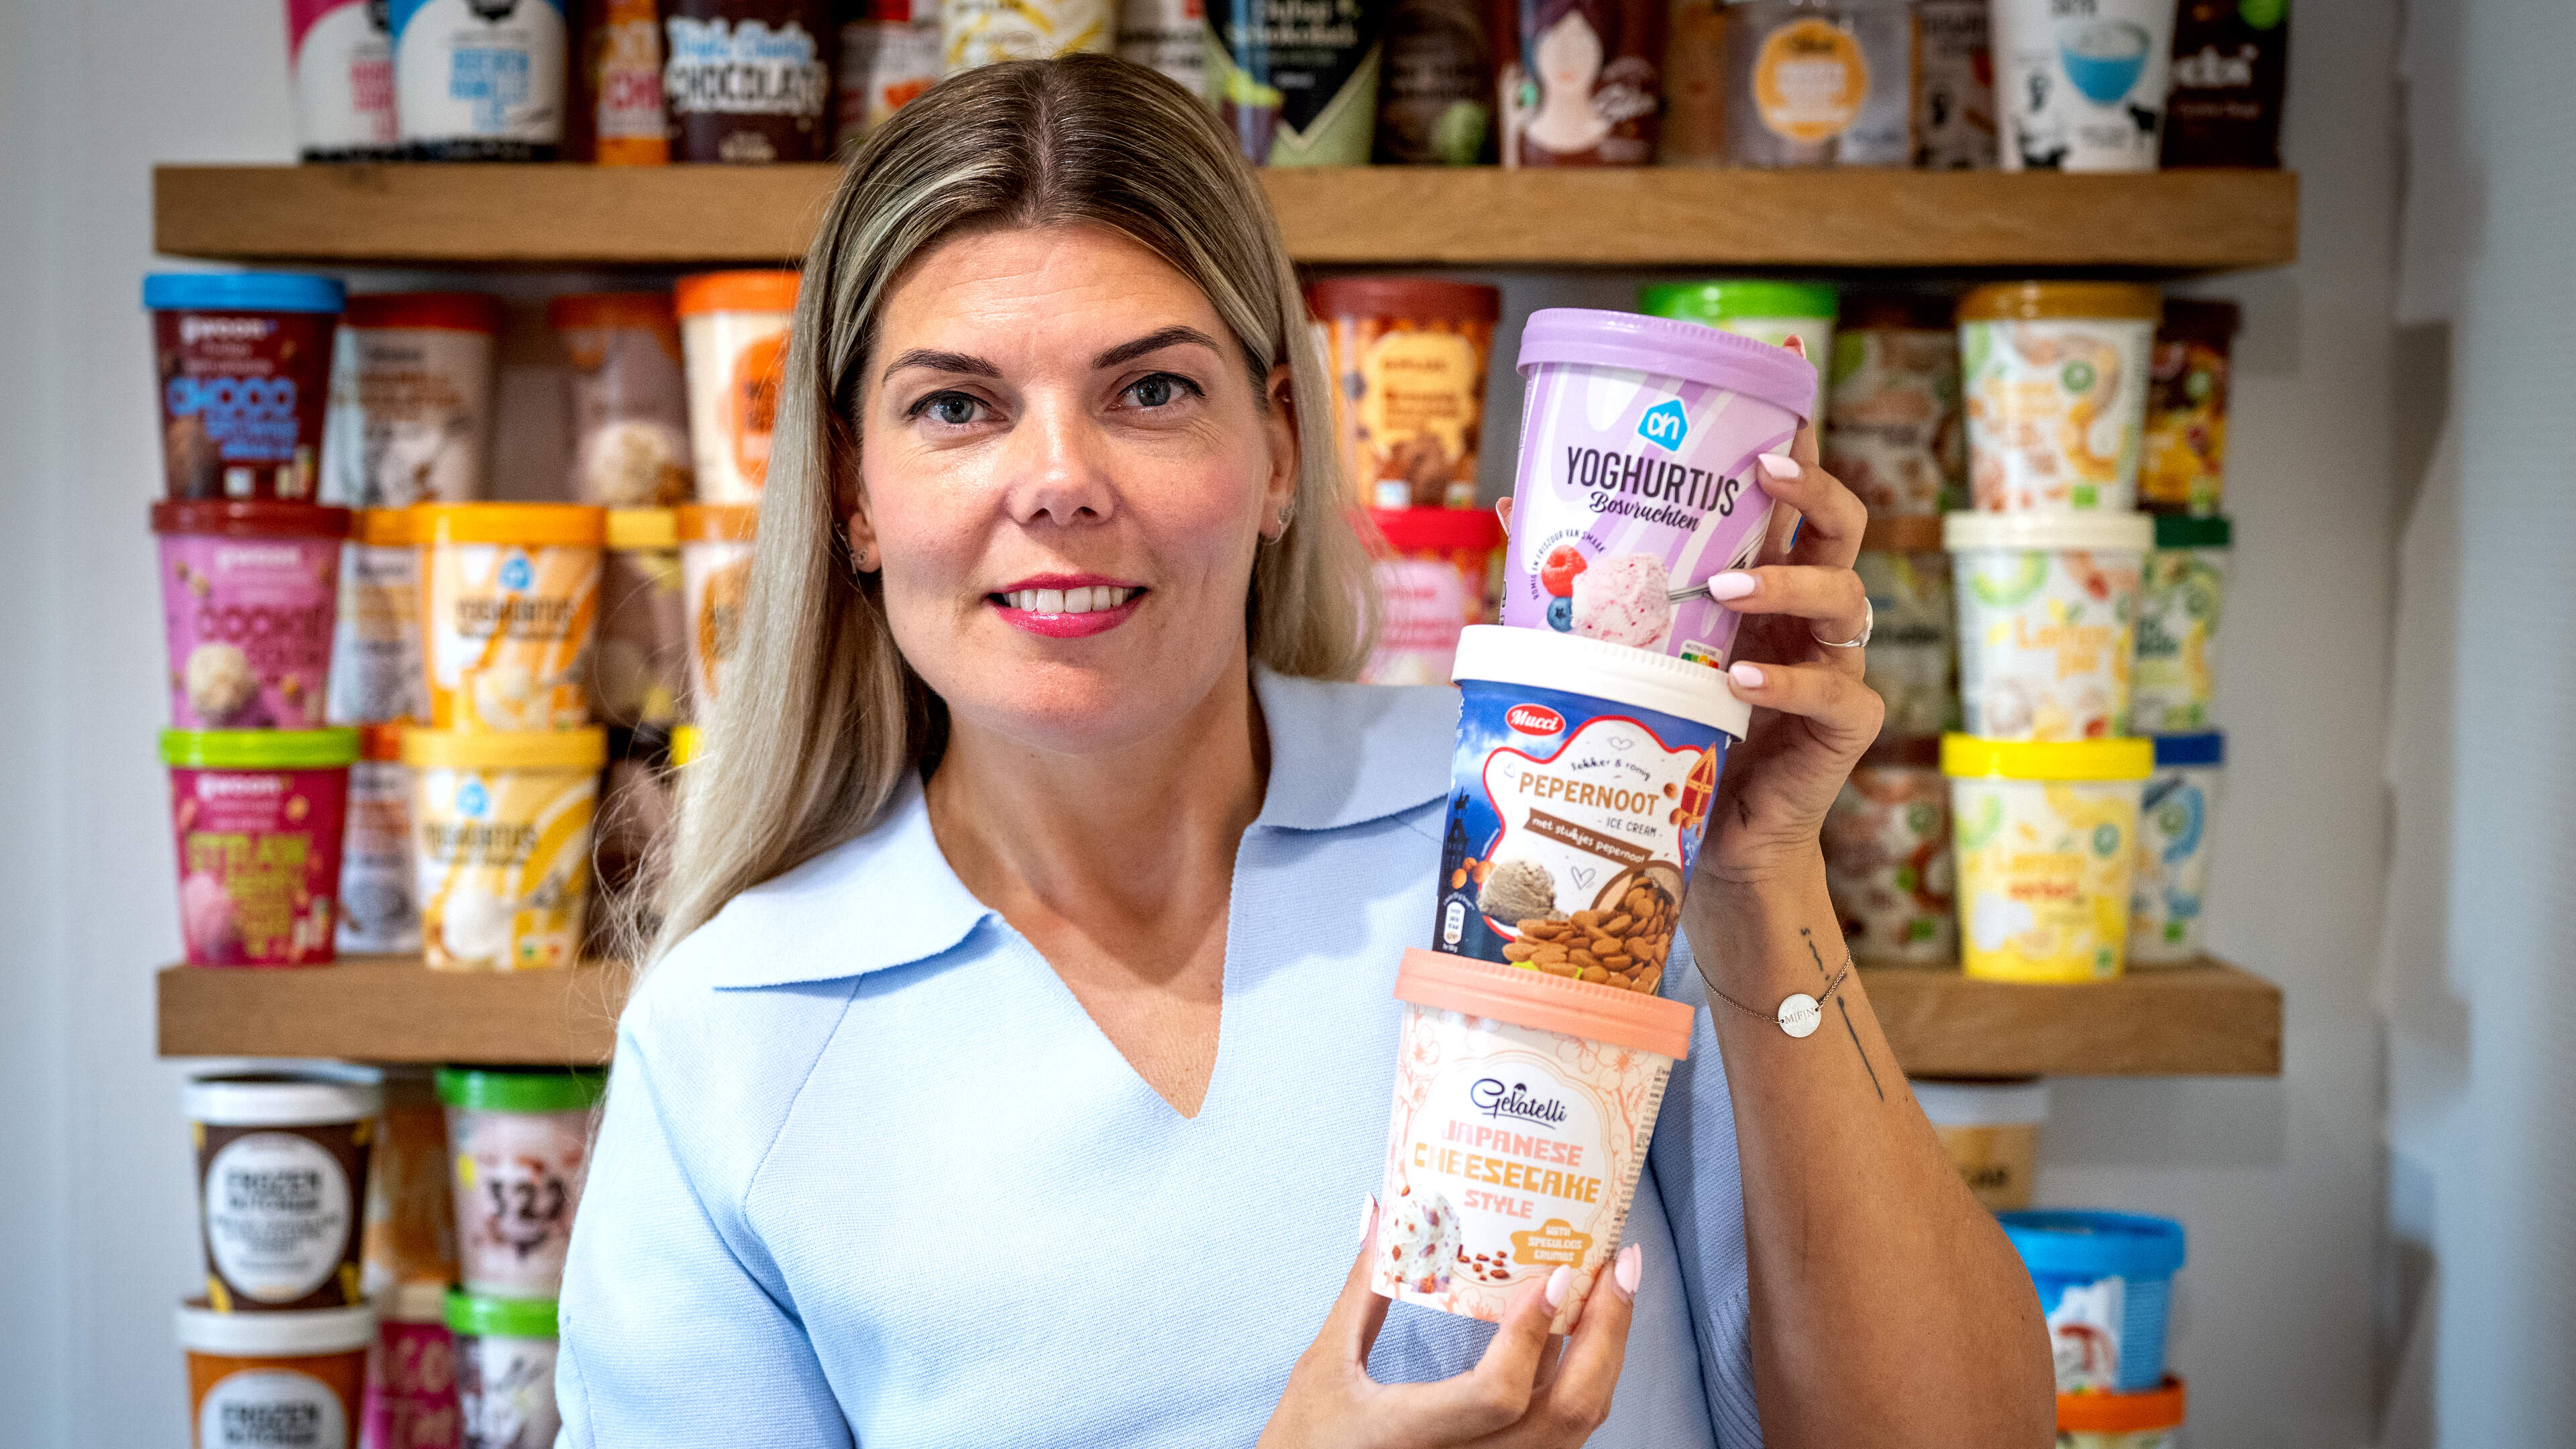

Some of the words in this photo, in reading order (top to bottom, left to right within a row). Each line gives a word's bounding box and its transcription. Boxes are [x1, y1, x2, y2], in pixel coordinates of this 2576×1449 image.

[1567, 446, 1739, 517] YOGHURTIJS
[1589, 490, 1701, 532] Bosvruchten
[1530, 574, 1540, 600] ROMIG
[1566, 529, 1580, 537] VAN
[1582, 531, 1606, 554] SMAAK
[1511, 710, 1560, 731] Mucci
[1570, 757, 1610, 771] lekker
[1625, 762, 1652, 782] romig
[1519, 771, 1660, 816] PEPERNOOT
[1532, 817, 1553, 831] met
[1556, 824, 1594, 847] stukjes
[1595, 840, 1646, 864] pepernoot
[1606, 817, 1623, 830] ICE
[1626, 820, 1658, 837] CREAM
[1470, 1078, 1567, 1122] Gelatelli
[1442, 1120, 1584, 1167] JAPANESE
[1414, 1142, 1601, 1204] CHEESECAKE
[1464, 1189, 1534, 1220] STYLE
[1546, 1226, 1570, 1236] WITH
